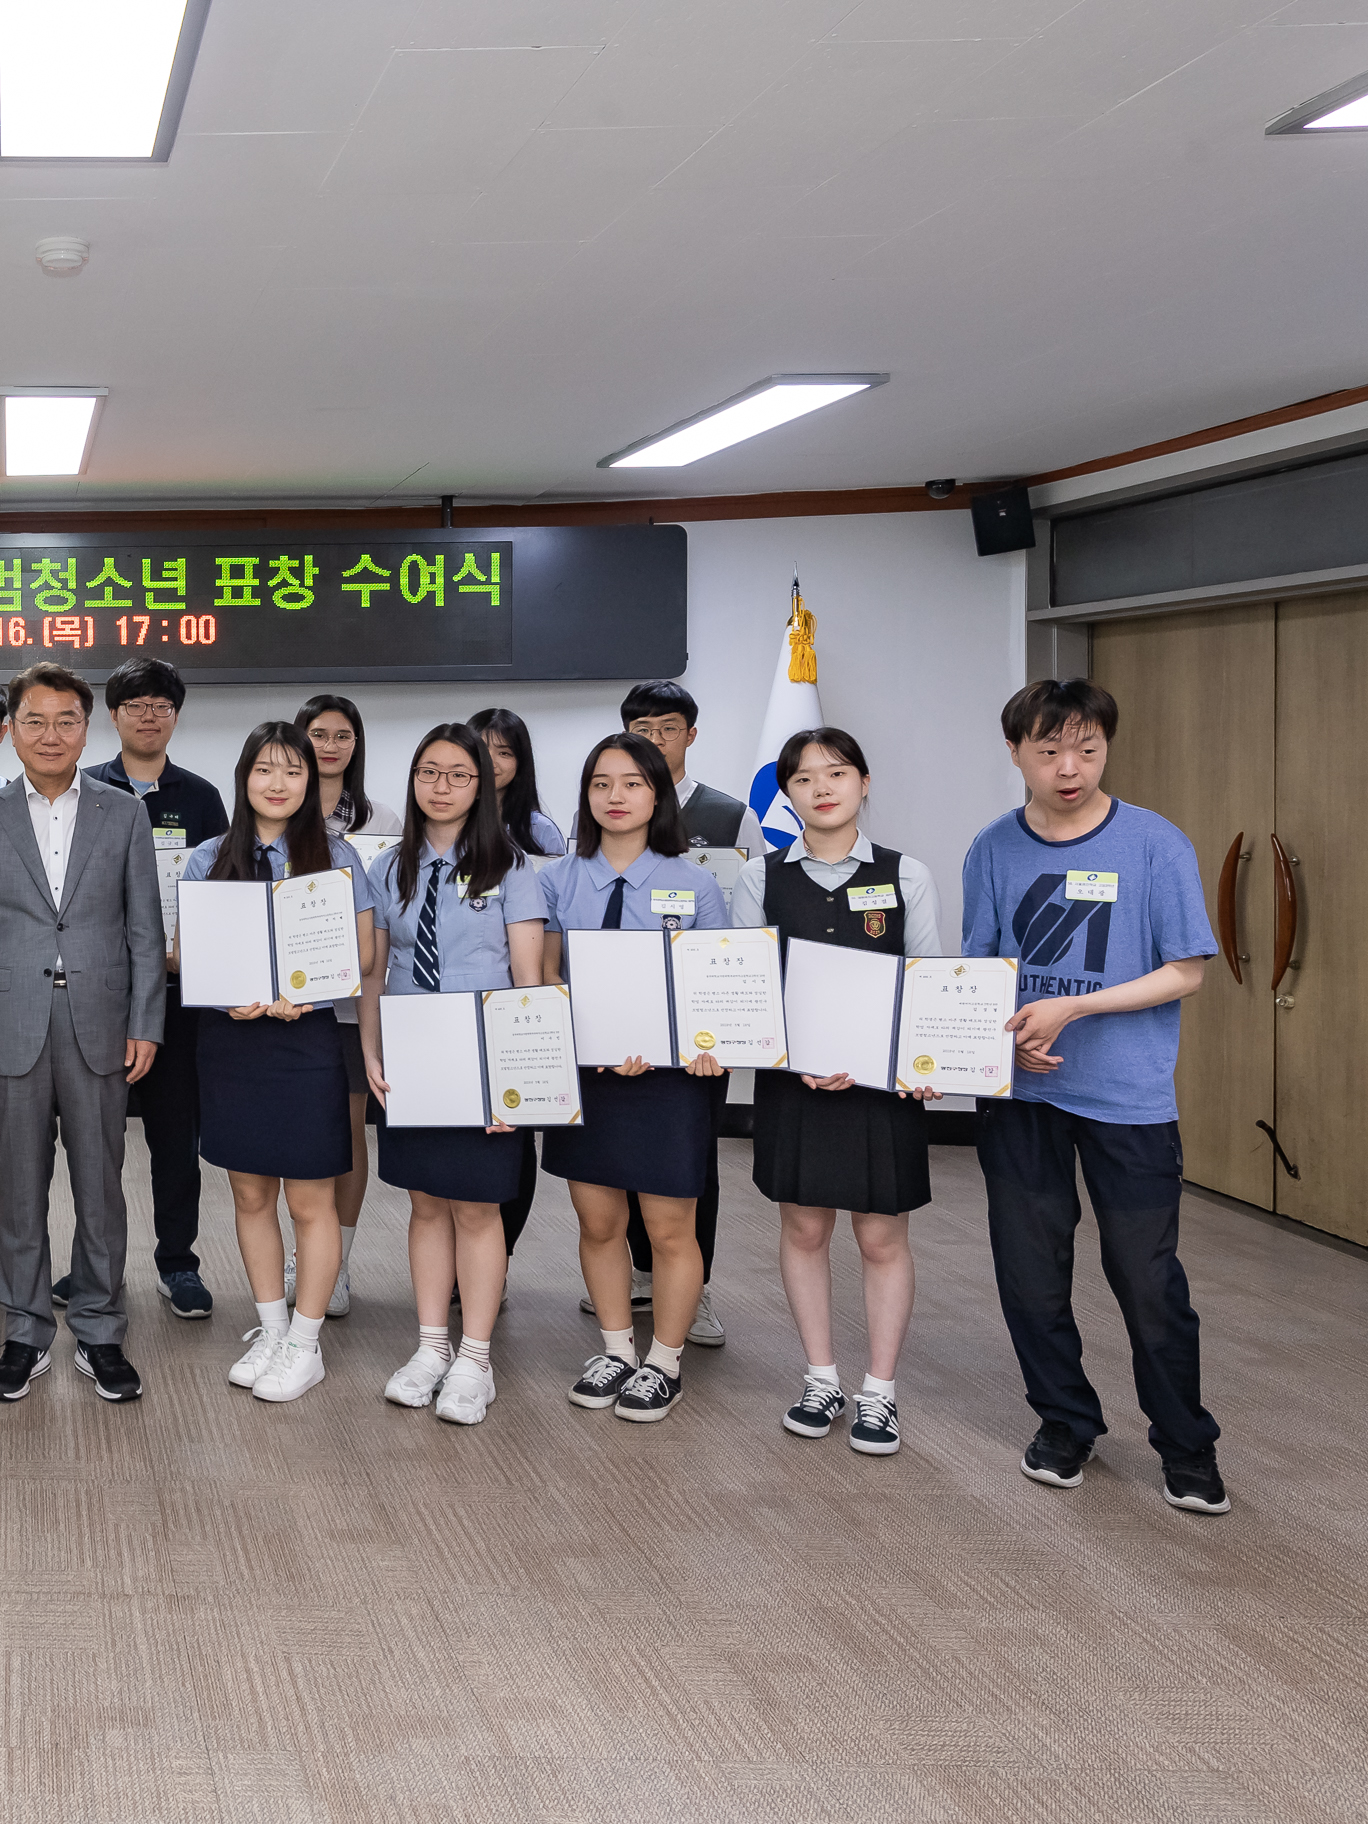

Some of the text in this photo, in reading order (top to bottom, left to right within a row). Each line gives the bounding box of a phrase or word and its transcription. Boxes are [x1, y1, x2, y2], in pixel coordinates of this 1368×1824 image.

[214, 554, 319, 610] 표창
[341, 552, 500, 608] 수여식
[1019, 973, 1103, 996] UTHENTIC
